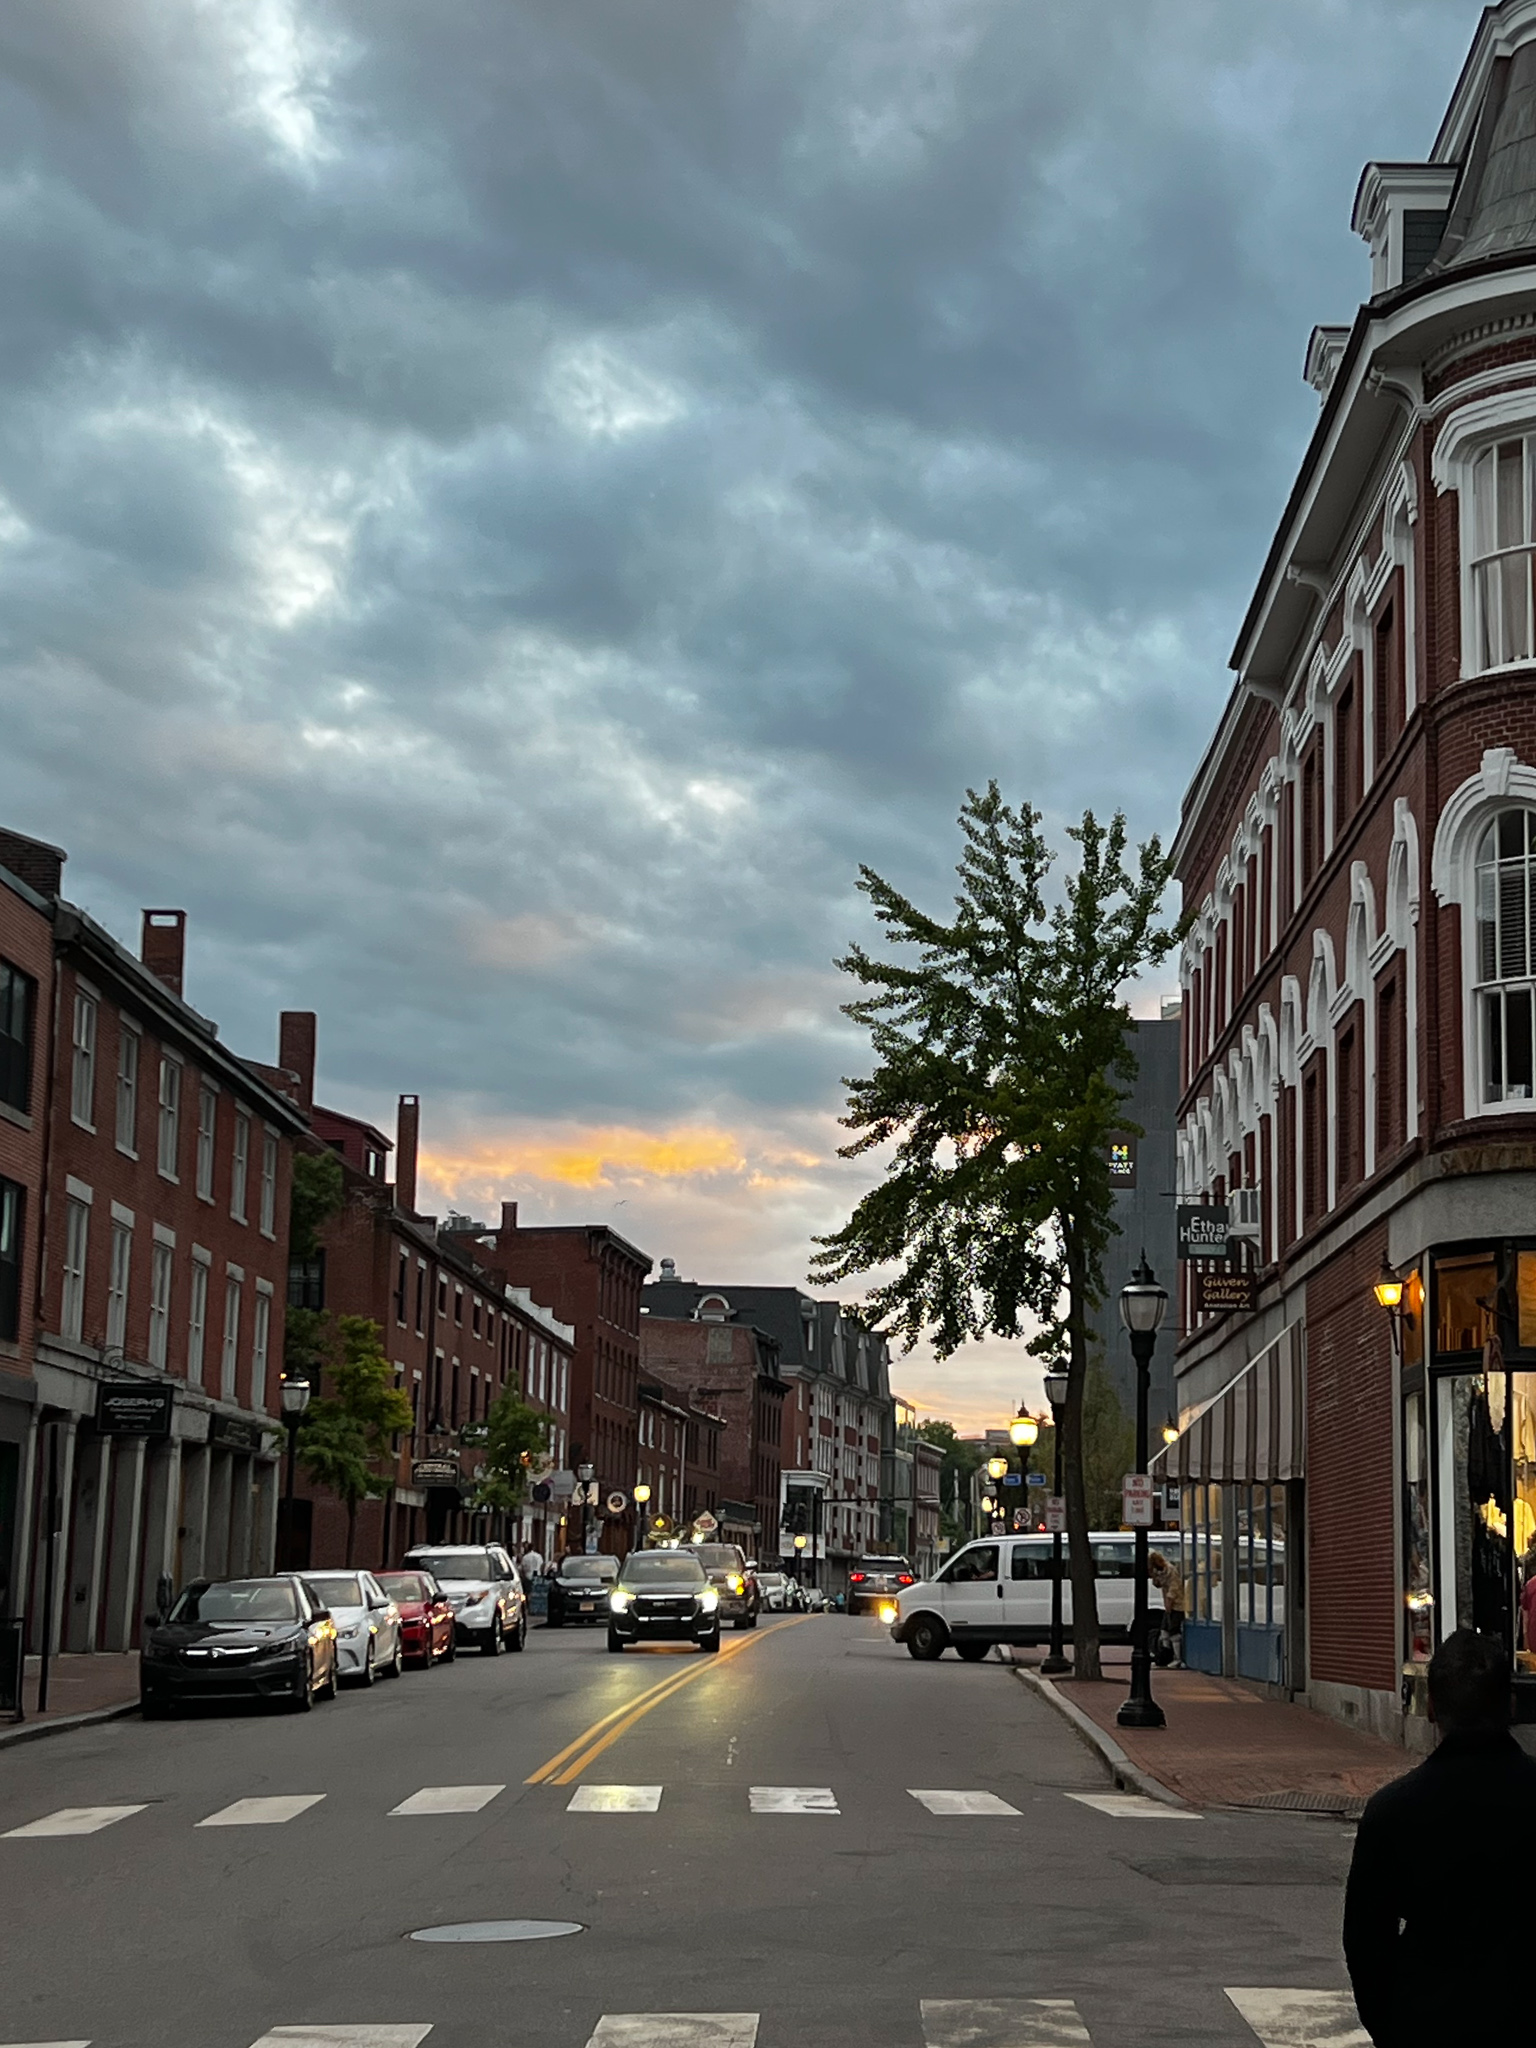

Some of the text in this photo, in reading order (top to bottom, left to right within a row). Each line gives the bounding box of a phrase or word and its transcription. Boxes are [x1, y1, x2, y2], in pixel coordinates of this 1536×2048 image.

[1190, 1216, 1230, 1233] Etha
[1180, 1226, 1227, 1243] Hunte
[1203, 1288, 1250, 1302] Gallery
[1131, 1477, 1145, 1488] NO
